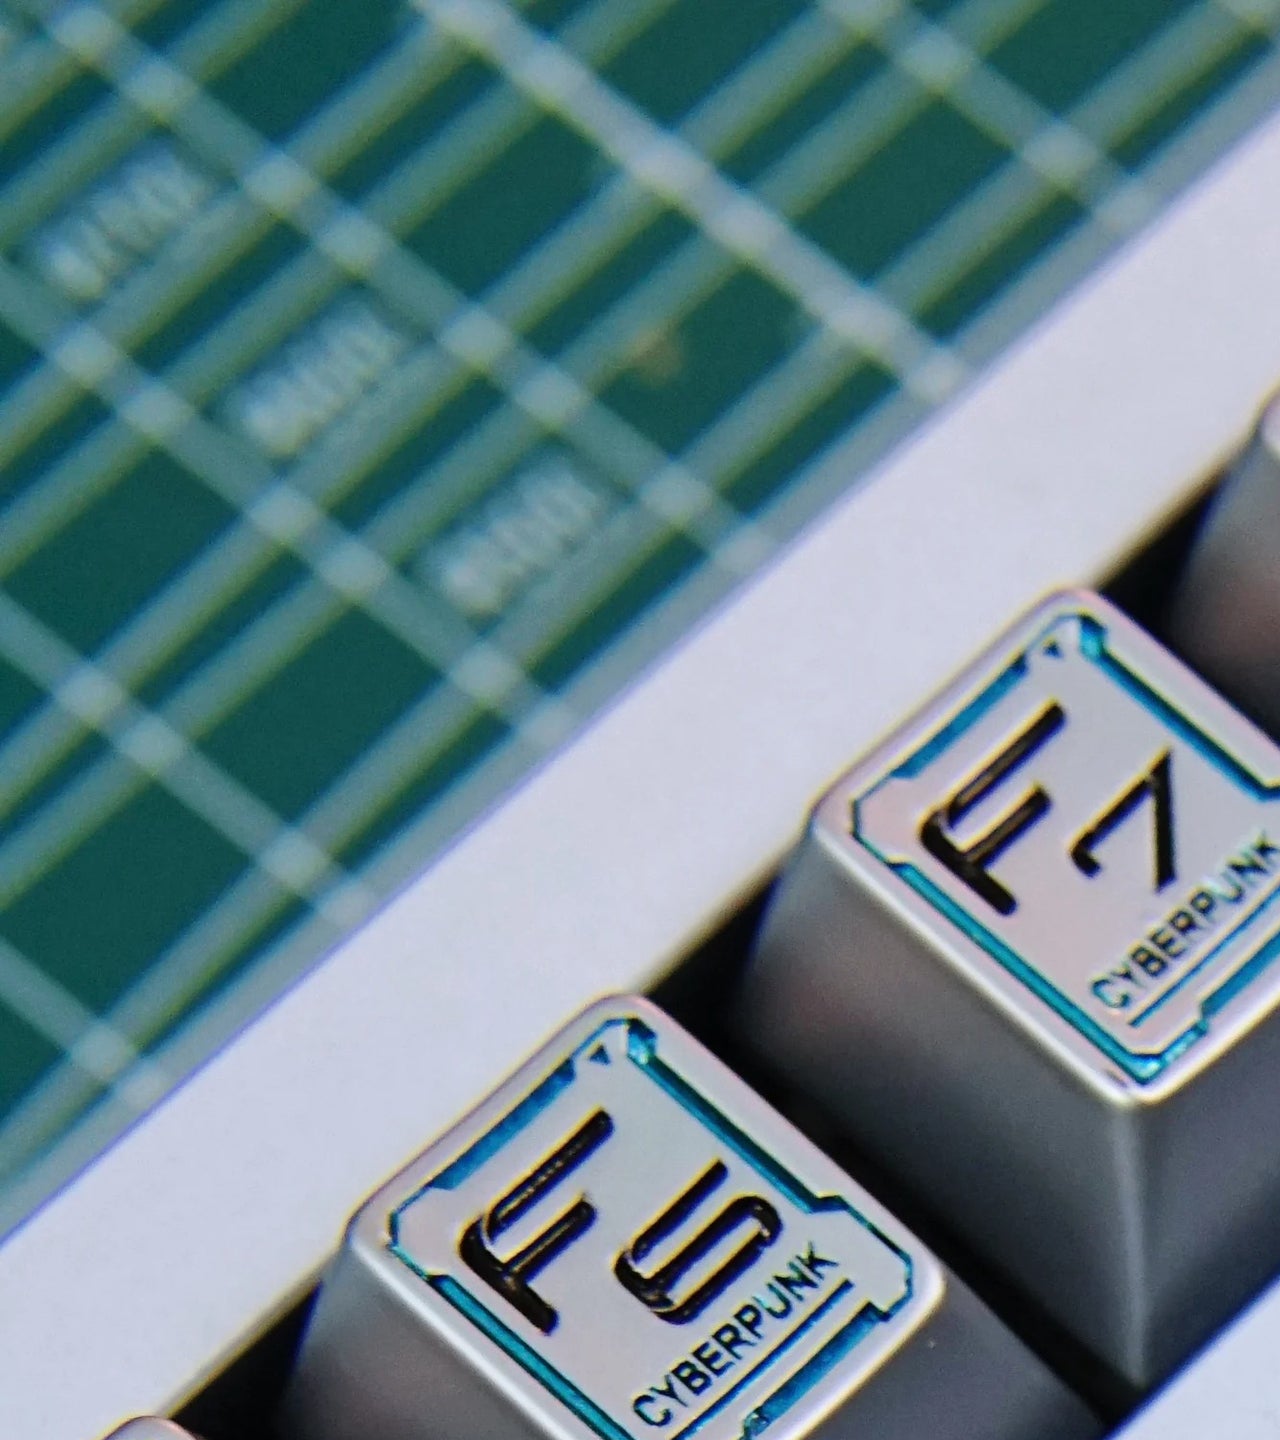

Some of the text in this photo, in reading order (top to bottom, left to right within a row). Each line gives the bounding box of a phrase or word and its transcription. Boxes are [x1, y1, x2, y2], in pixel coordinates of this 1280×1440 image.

[918, 700, 1177, 916] F7
[457, 1108, 784, 1336] F6
[630, 1241, 840, 1430] CYBERPUNK
